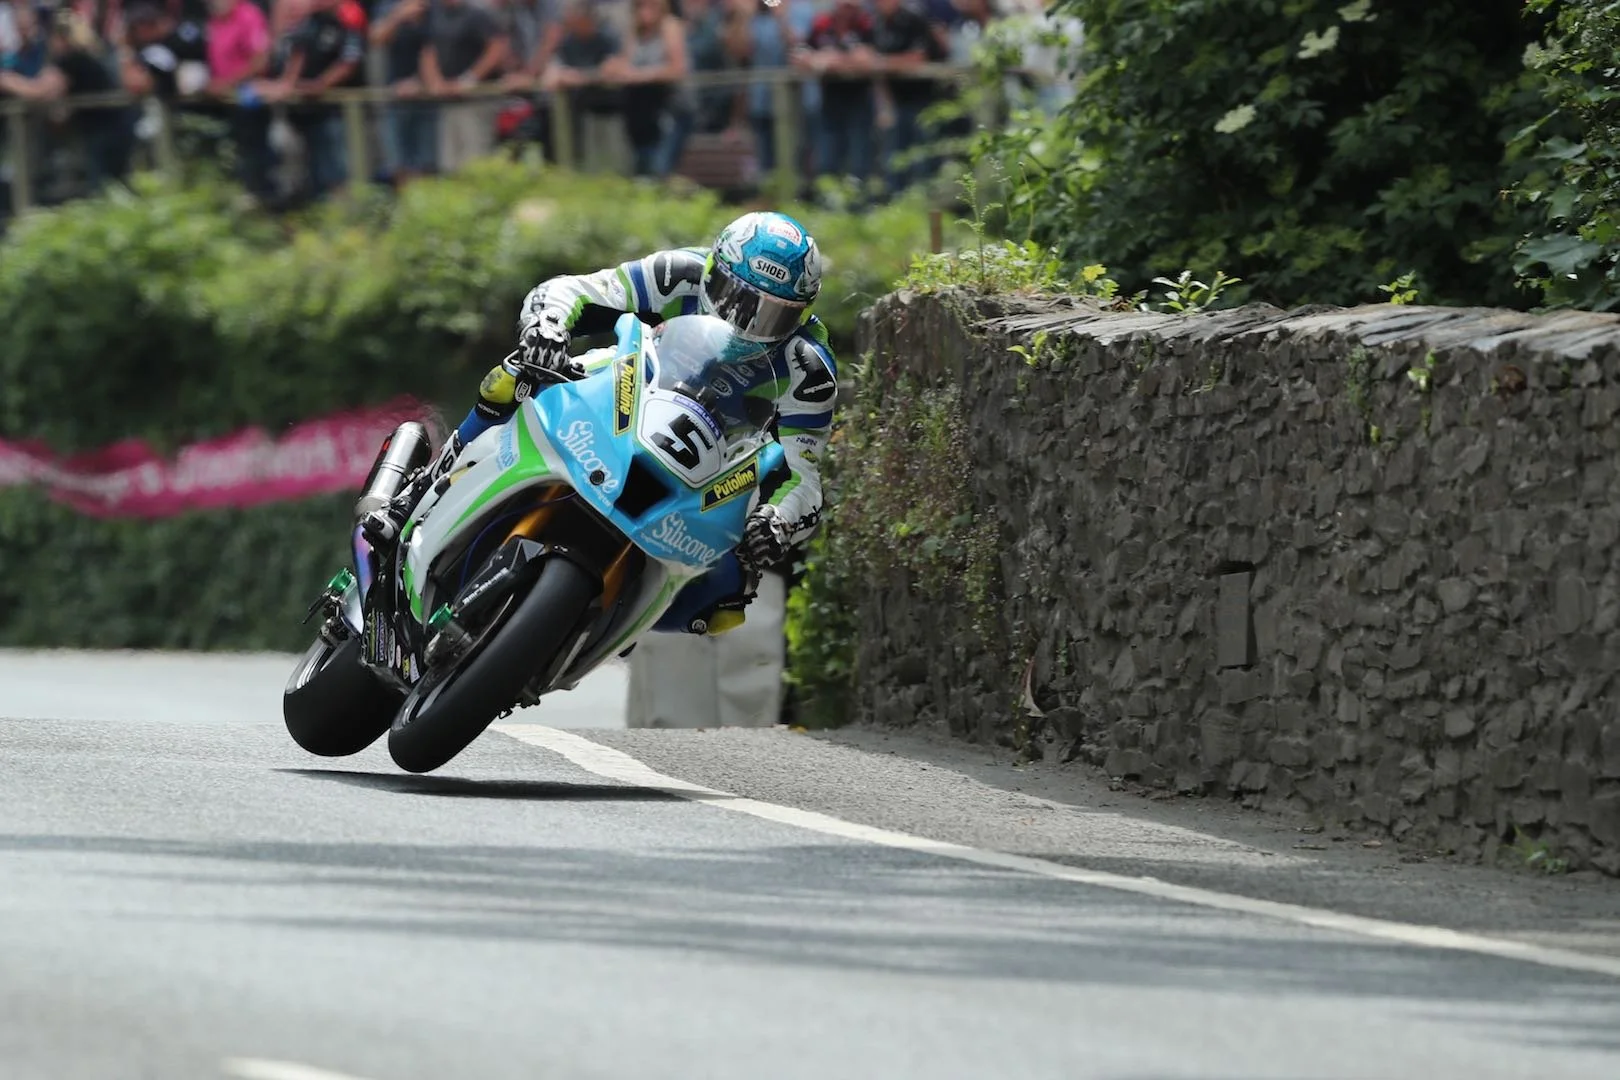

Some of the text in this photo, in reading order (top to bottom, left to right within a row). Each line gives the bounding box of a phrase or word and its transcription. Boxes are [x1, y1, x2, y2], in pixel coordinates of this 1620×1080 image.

[755, 260, 787, 281] SHOEI
[620, 363, 634, 415] Putoline
[556, 420, 619, 493] Silicone
[650, 413, 713, 470] 5
[713, 470, 755, 499] Putoline
[652, 511, 716, 562] Silicone
